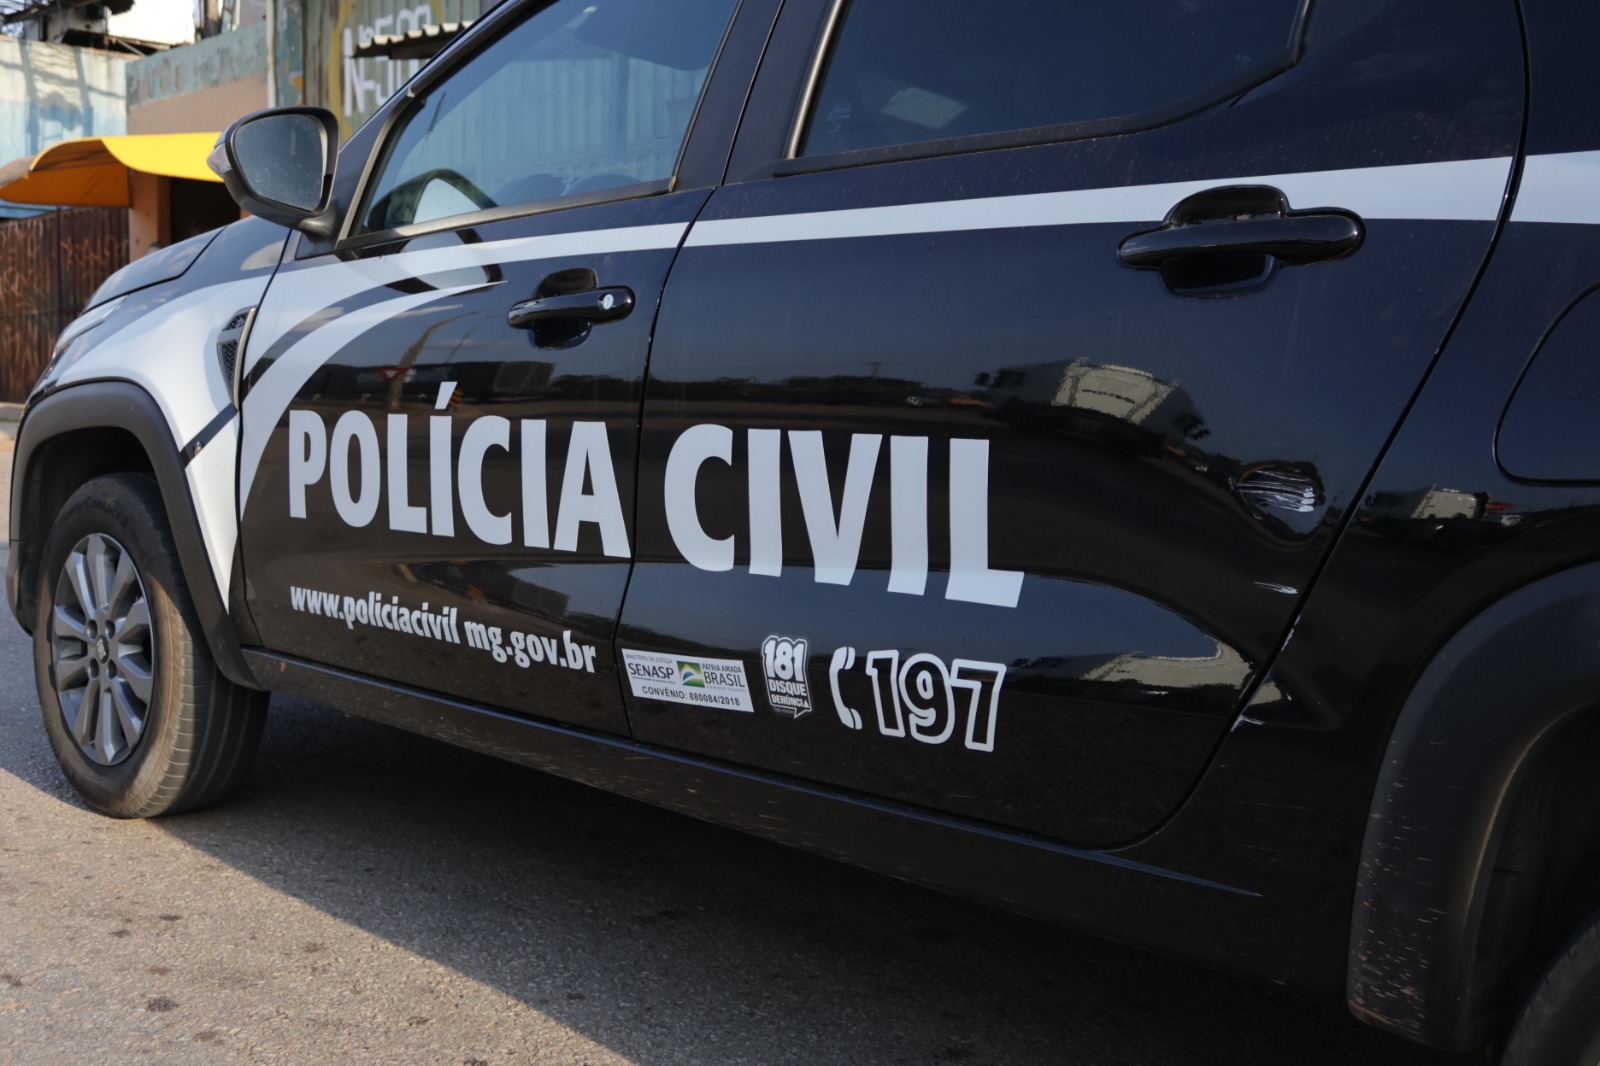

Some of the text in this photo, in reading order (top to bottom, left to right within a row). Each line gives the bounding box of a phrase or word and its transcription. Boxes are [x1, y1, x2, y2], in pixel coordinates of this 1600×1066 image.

[289, 381, 1025, 608] POLÍCIA CIVIL
[290, 586, 596, 673] www.policiacivil mg.gov.br
[701, 661, 742, 674] PÁTRIA AMADA
[764, 639, 805, 682] 181
[628, 662, 674, 680] SENASP
[703, 671, 746, 688] BRASIL
[642, 685, 740, 706] CONVÊNIO: 880084/2018
[768, 679, 807, 697] DISQUE
[771, 694, 810, 708] DENÚNCIA
[866, 649, 1007, 752] 197
